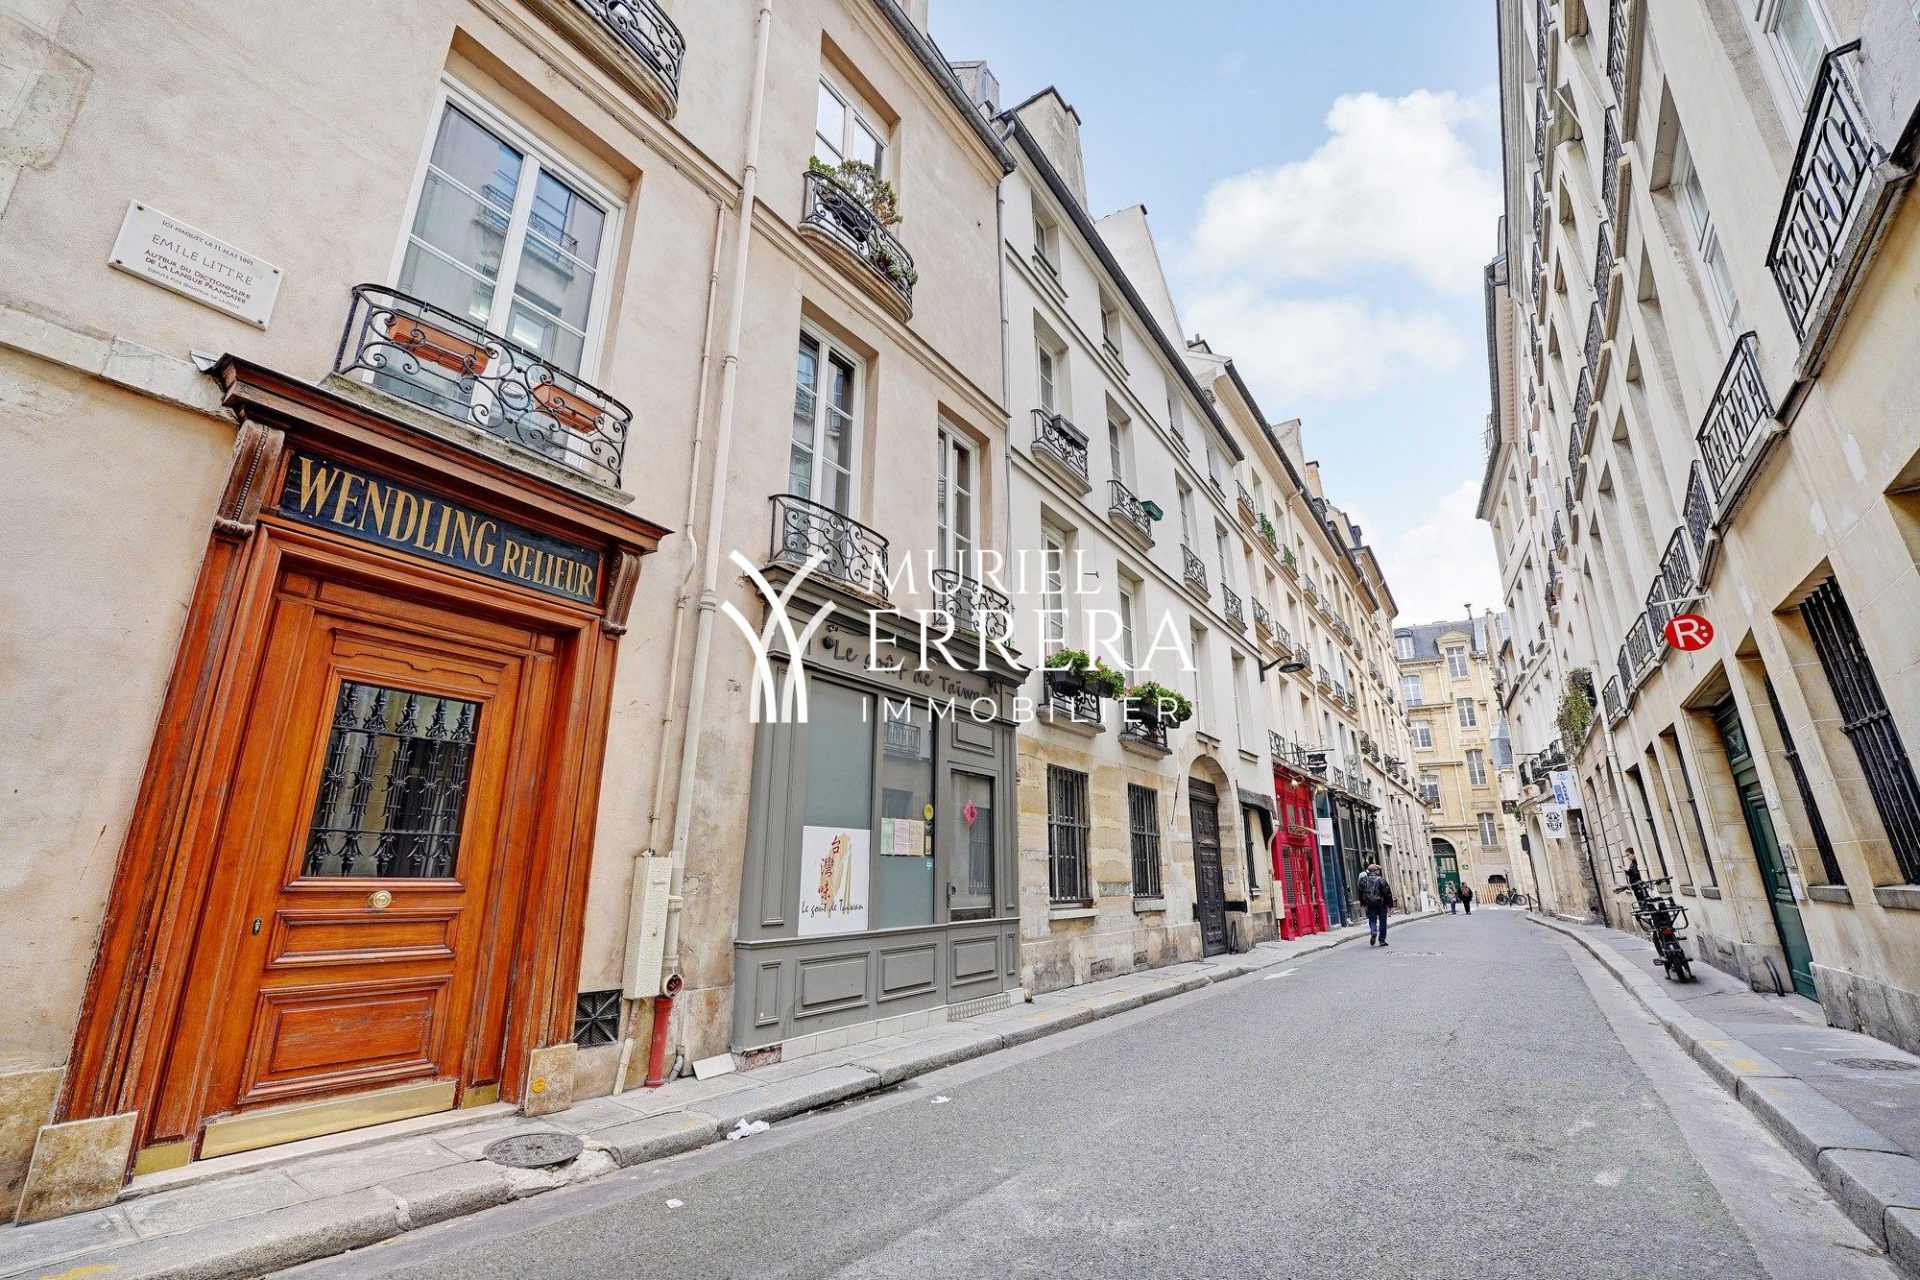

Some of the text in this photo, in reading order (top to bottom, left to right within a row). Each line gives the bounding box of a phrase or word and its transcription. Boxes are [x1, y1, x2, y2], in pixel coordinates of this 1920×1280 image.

[152, 234, 199, 262] EMILE
[162, 220, 173, 229] ICI
[175, 227, 204, 243] NAQUIT
[204, 240, 213, 248] LE
[213, 244, 221, 252] 11
[222, 249, 238, 258] MAI
[144, 249, 251, 300] AUTEUR DU DICTIONNAIRE
[145, 257, 247, 304] DE LA LANGUE FRANÇAISE
[299, 456, 593, 599] WENDLING RELIEUR
[833, 639, 858, 662] Le
[818, 835, 841, 900] 台灣味
[801, 901, 809, 914] Le
[810, 902, 827, 918] goût
[828, 900, 837, 913] de
